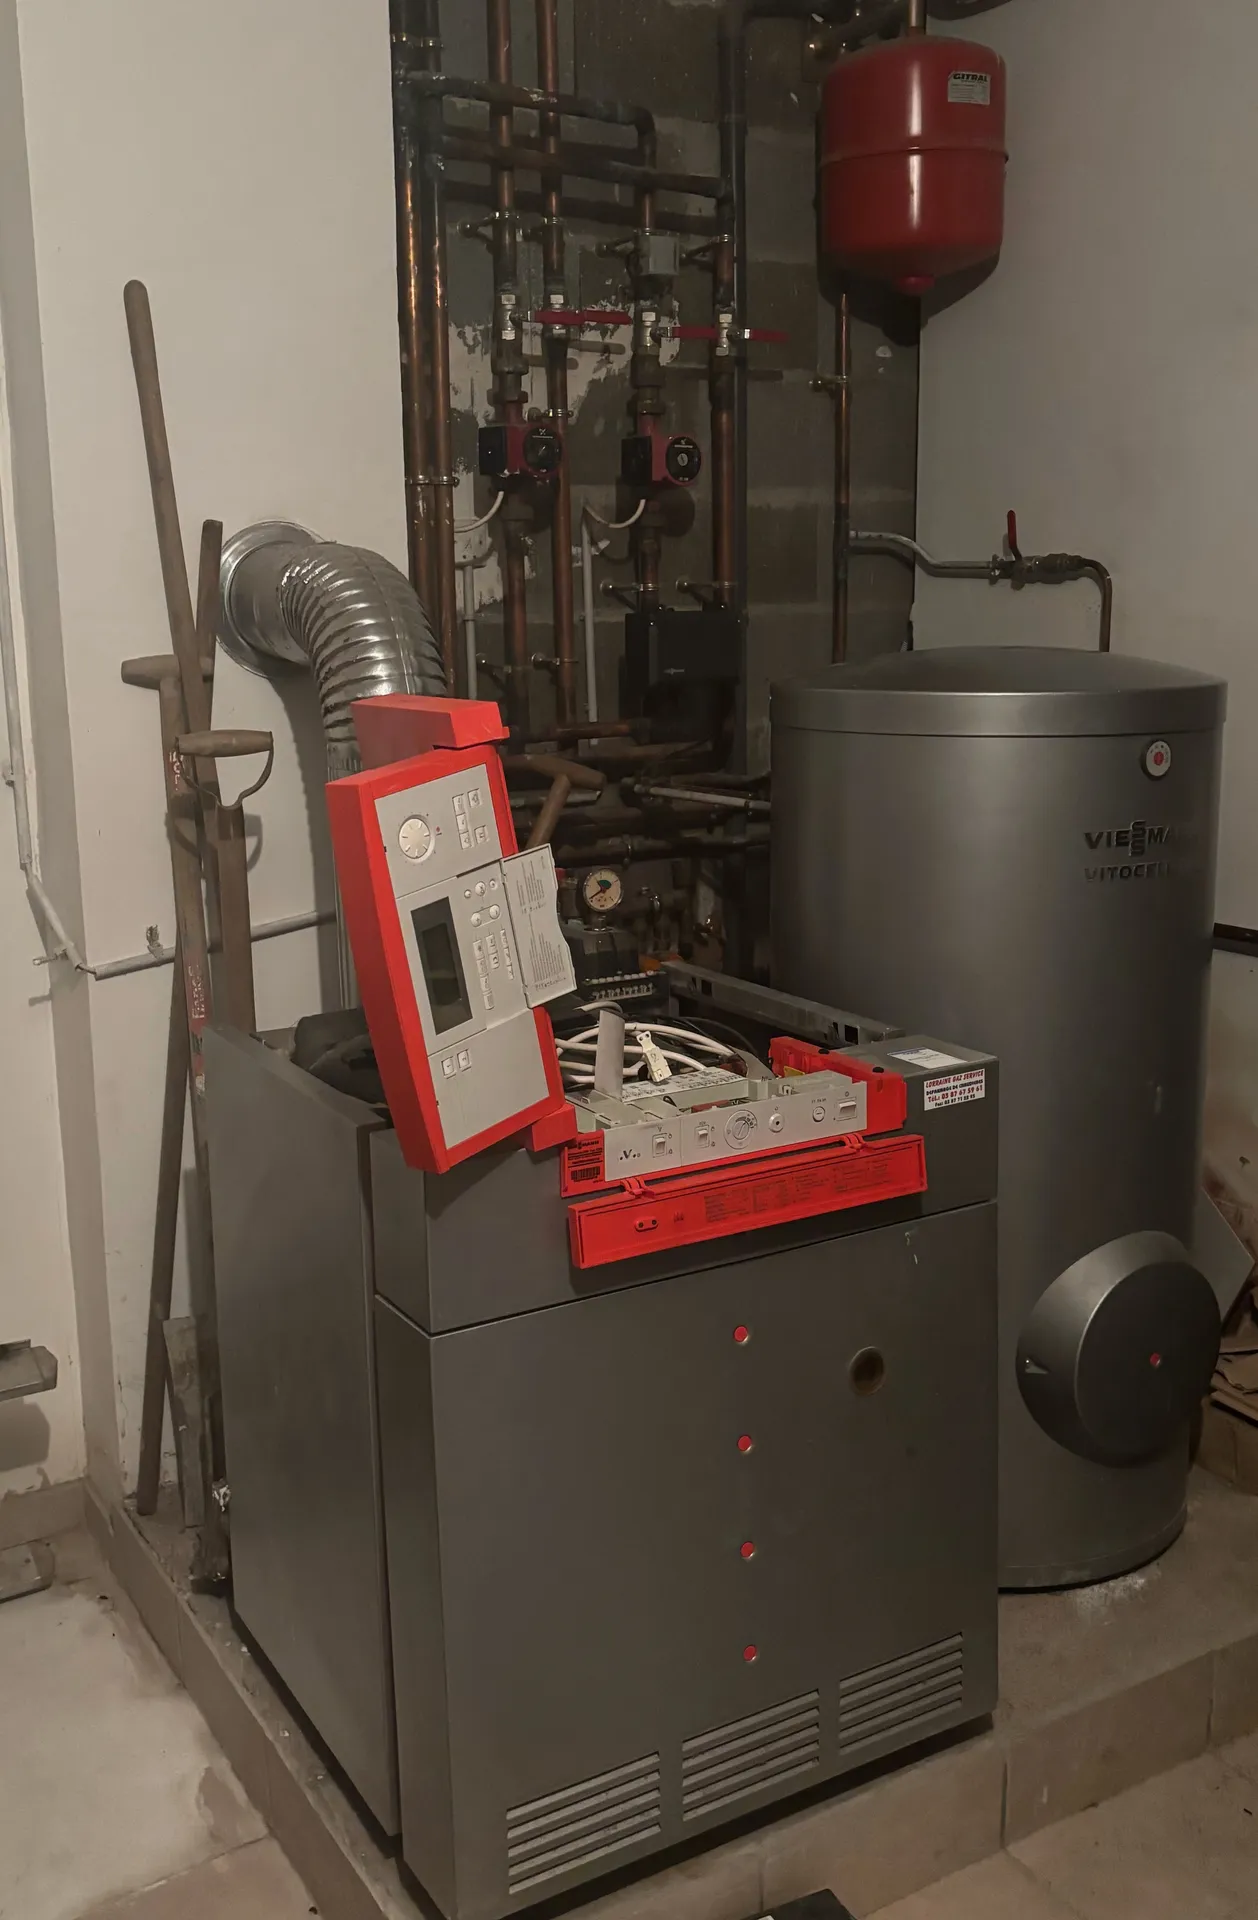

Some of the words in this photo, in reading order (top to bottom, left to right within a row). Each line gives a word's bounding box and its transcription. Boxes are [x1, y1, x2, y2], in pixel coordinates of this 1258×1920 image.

[926, 1077, 951, 1088] LORRAINE
[953, 1075, 962, 1083] GAZ
[963, 1070, 983, 1080] SERVICE
